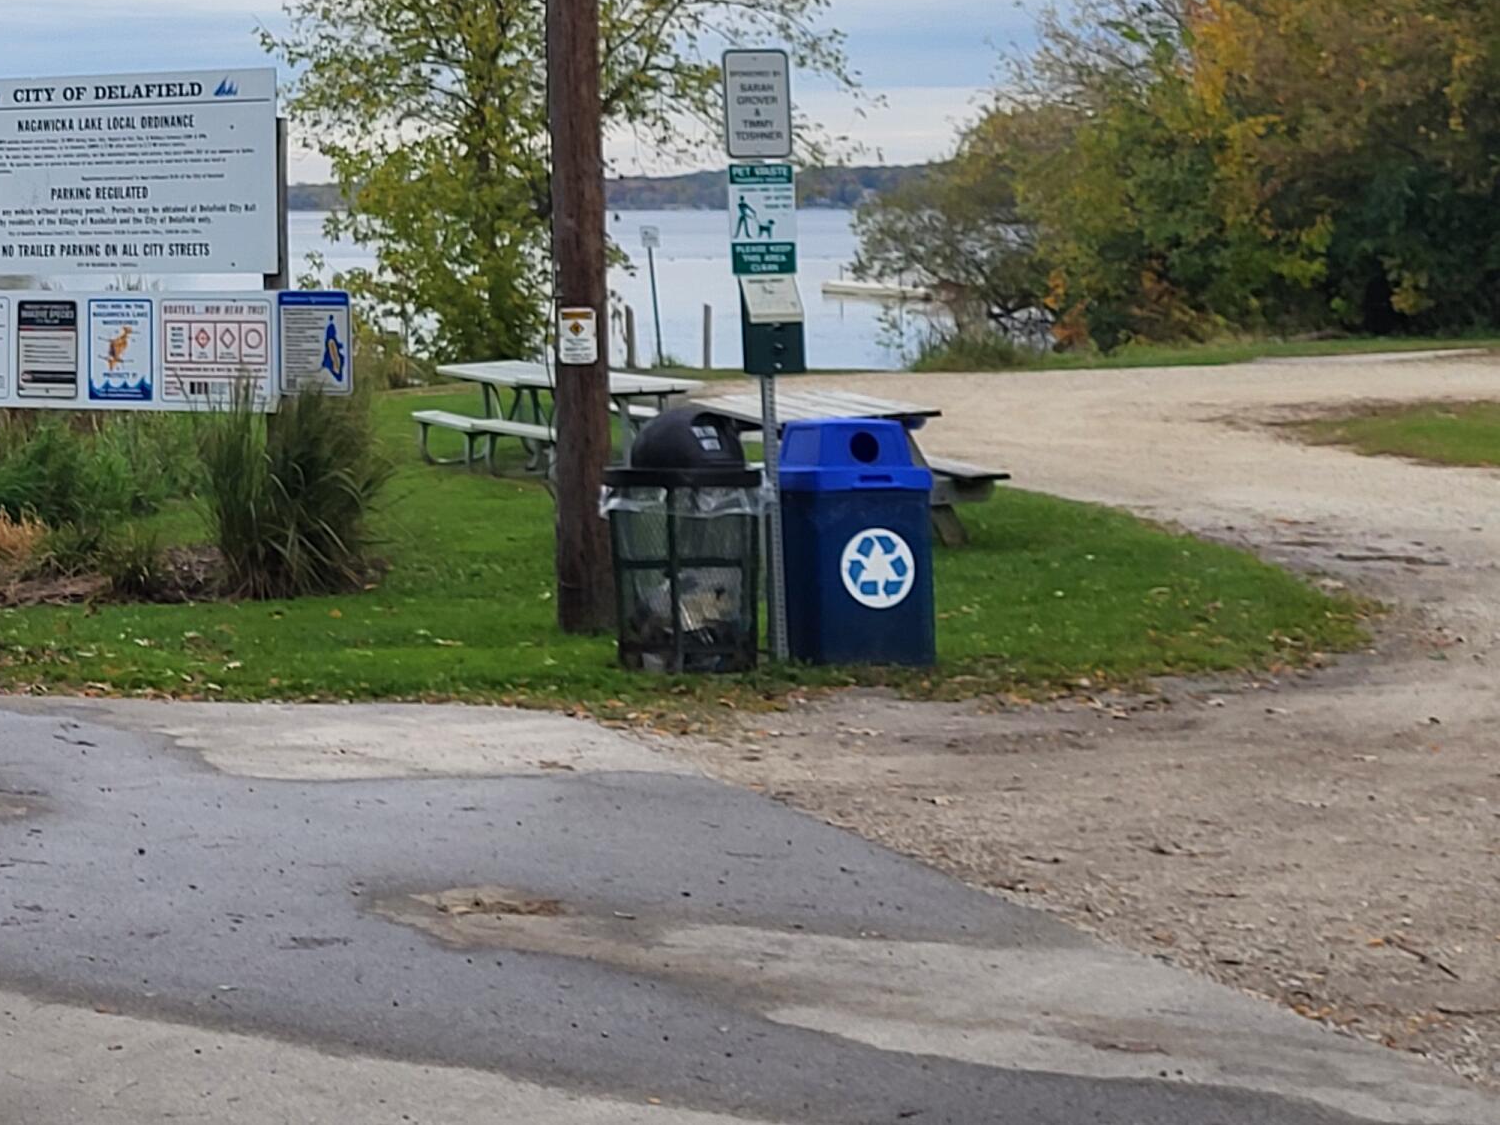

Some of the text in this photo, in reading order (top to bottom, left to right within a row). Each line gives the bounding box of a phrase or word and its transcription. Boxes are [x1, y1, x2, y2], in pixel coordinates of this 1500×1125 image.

[740, 83, 774, 92] SARAH
[13, 82, 203, 104] CITY OF DELAFIELD
[736, 95, 778, 105] GROVER
[755, 108, 761, 117] &
[17, 114, 195, 132] NAGAWICKA LAKE LOCAL ORDINANCE
[742, 119, 774, 128] TIMMY
[735, 131, 784, 140] TOSHNER
[731, 166, 789, 176] PET WASTE
[51, 186, 149, 201] PARKING REGULATED
[2, 210, 12, 218] any
[14, 208, 34, 216] vehicle
[60, 207, 83, 217] parking
[85, 207, 106, 216] permit.
[111, 206, 136, 215] Permits
[138, 207, 150, 215] may
[152, 205, 160, 213] be
[162, 205, 188, 213] obtained
[199, 204, 227, 213] Delafield
[229, 203, 242, 213] City
[244, 203, 256, 212] Hall
[0, 219, 6, 227] by
[58, 217, 79, 226] Village
[80, 217, 88, 225] of
[89, 216, 117, 225] Nashotah
[119, 216, 130, 224] and
[132, 216, 143, 224] the
[145, 216, 158, 225] City
[159, 215, 167, 223] of
[168, 215, 196, 223] Delafield
[198, 215, 212, 224] only.
[2, 242, 210, 258] NO TRAILER PARKING ON ALL CITY STREETS
[735, 245, 793, 253] PLEASE KEEP
[742, 254, 787, 262] THIS AREA
[750, 263, 779, 272] CLEAN
[224, 305, 244, 315] HEAR
